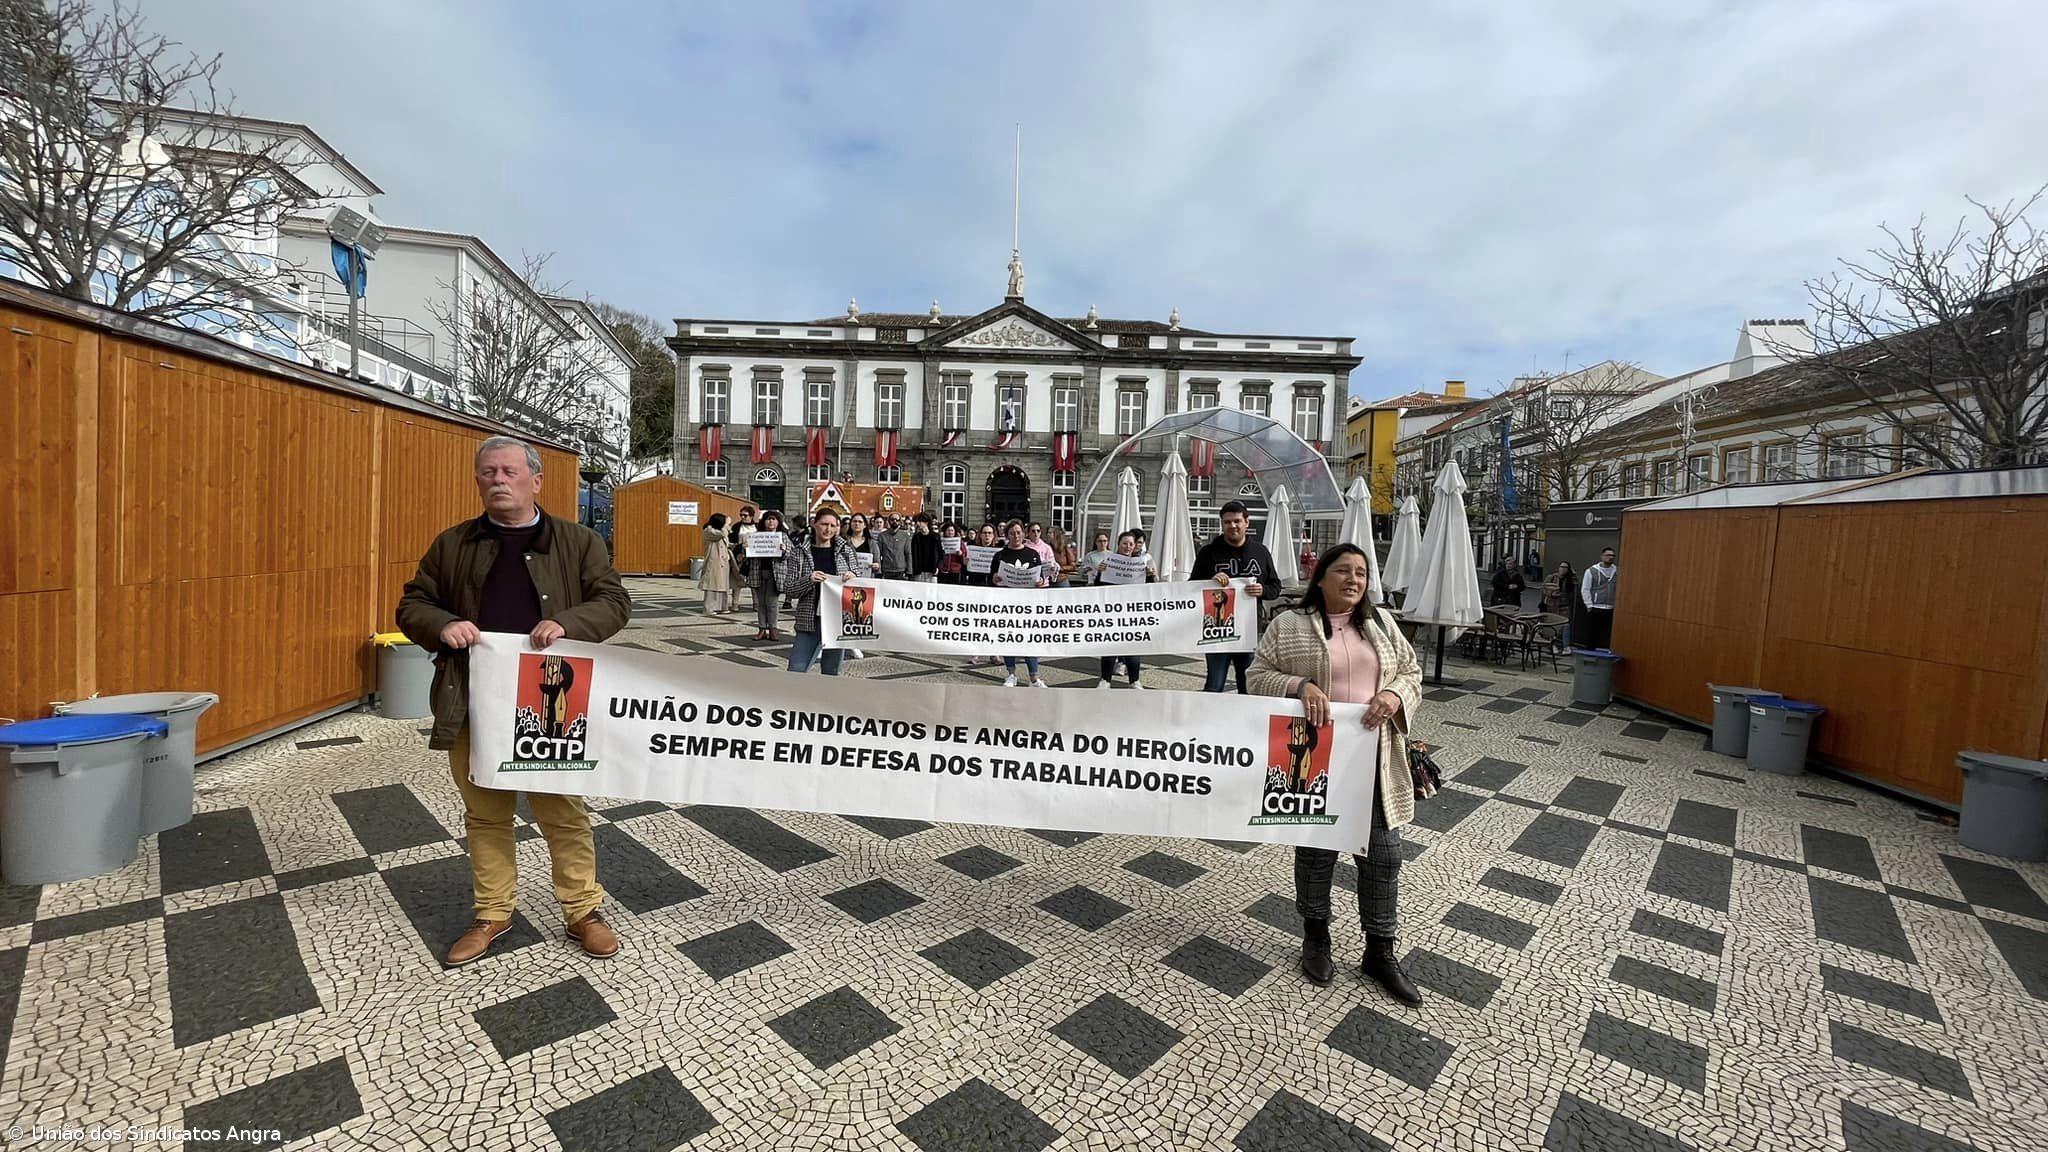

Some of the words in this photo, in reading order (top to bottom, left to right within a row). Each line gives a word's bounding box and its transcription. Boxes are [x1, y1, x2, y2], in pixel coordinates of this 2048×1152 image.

[882, 597, 923, 611] UNIÃO
[926, 601, 954, 612] DOS
[956, 602, 1033, 615] SINDICATOS
[1035, 605, 1053, 615] DE
[1055, 603, 1101, 615] ANGRA
[1104, 603, 1123, 613] DO
[1126, 598, 1197, 613] HEROÍSMO
[843, 623, 873, 635] CGTP
[919, 615, 949, 626] COM
[952, 617, 970, 627] OS
[972, 617, 1085, 629] TRABALHADORES
[1087, 617, 1114, 628] DAS
[1117, 616, 1160, 627] ILHAS:
[926, 630, 994, 644] TERCEIRA,
[997, 631, 1024, 644] SÃO
[1027, 633, 1070, 644] JORGE
[1073, 633, 1081, 643] E
[1084, 631, 1152, 643] GRACIOSA
[1203, 626, 1234, 639] CGTP
[609, 695, 698, 723] UNIÃO
[706, 704, 763, 728] DOS
[769, 709, 927, 740] SINDICATOS
[934, 724, 969, 744] DE
[974, 727, 1065, 752] ANGRA
[1072, 734, 1109, 755] DO
[1116, 737, 1254, 768] HEROÍSMO
[515, 736, 584, 761] CGTP
[503, 762, 556, 770] INTERSINDICAL
[557, 762, 592, 770] NACIONAL
[649, 733, 766, 761] SEMPRE
[773, 742, 813, 764] EM
[820, 745, 921, 773] DEFESA
[929, 753, 983, 777] DOS
[989, 758, 1212, 796] TRABALHADORES
[1264, 792, 1325, 815] CGTP
